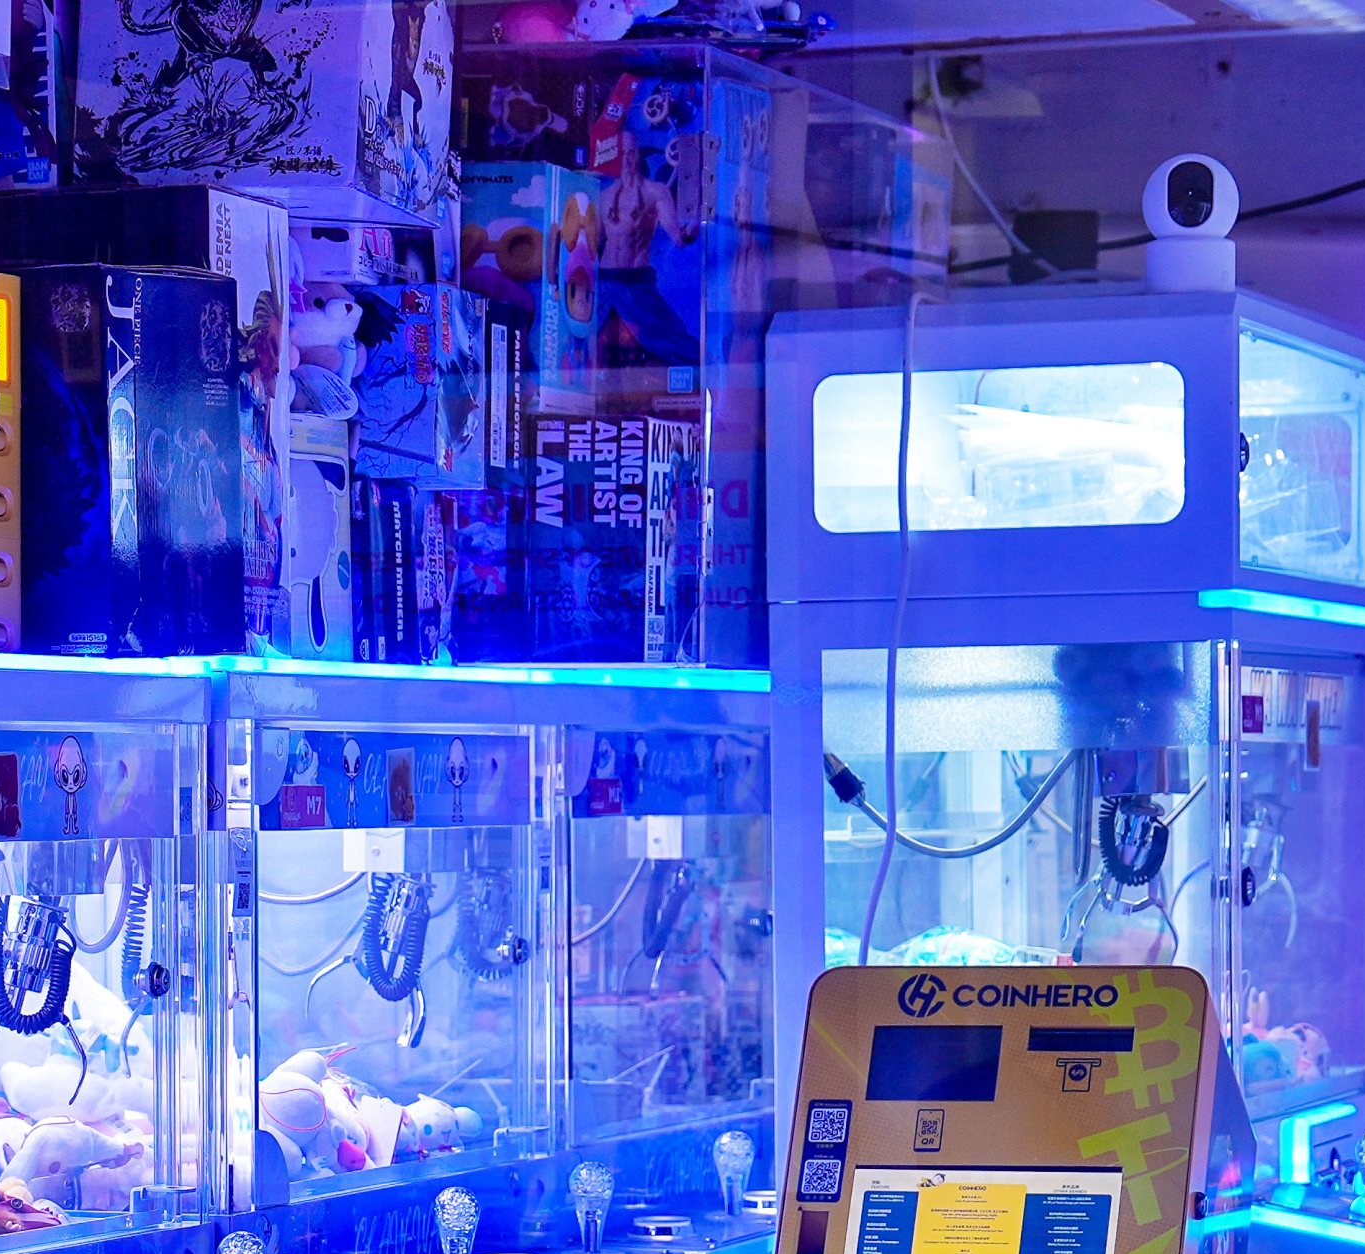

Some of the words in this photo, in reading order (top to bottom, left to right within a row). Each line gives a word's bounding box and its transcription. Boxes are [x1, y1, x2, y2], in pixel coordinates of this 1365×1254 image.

[224, 203, 232, 254] NEXT
[134, 277, 142, 314] ONE
[134, 318, 142, 365] PIECE
[513, 329, 522, 379] PANEL
[104, 274, 138, 541] JACK
[513, 382, 522, 470] SPECTACLE
[567, 419, 592, 463] THE
[620, 420, 644, 487] KING
[535, 428, 565, 529] LAW
[593, 419, 618, 529] ARTIST
[619, 494, 643, 529] OF
[306, 795, 322, 815] M7
[952, 983, 1119, 1008] COINHERO
